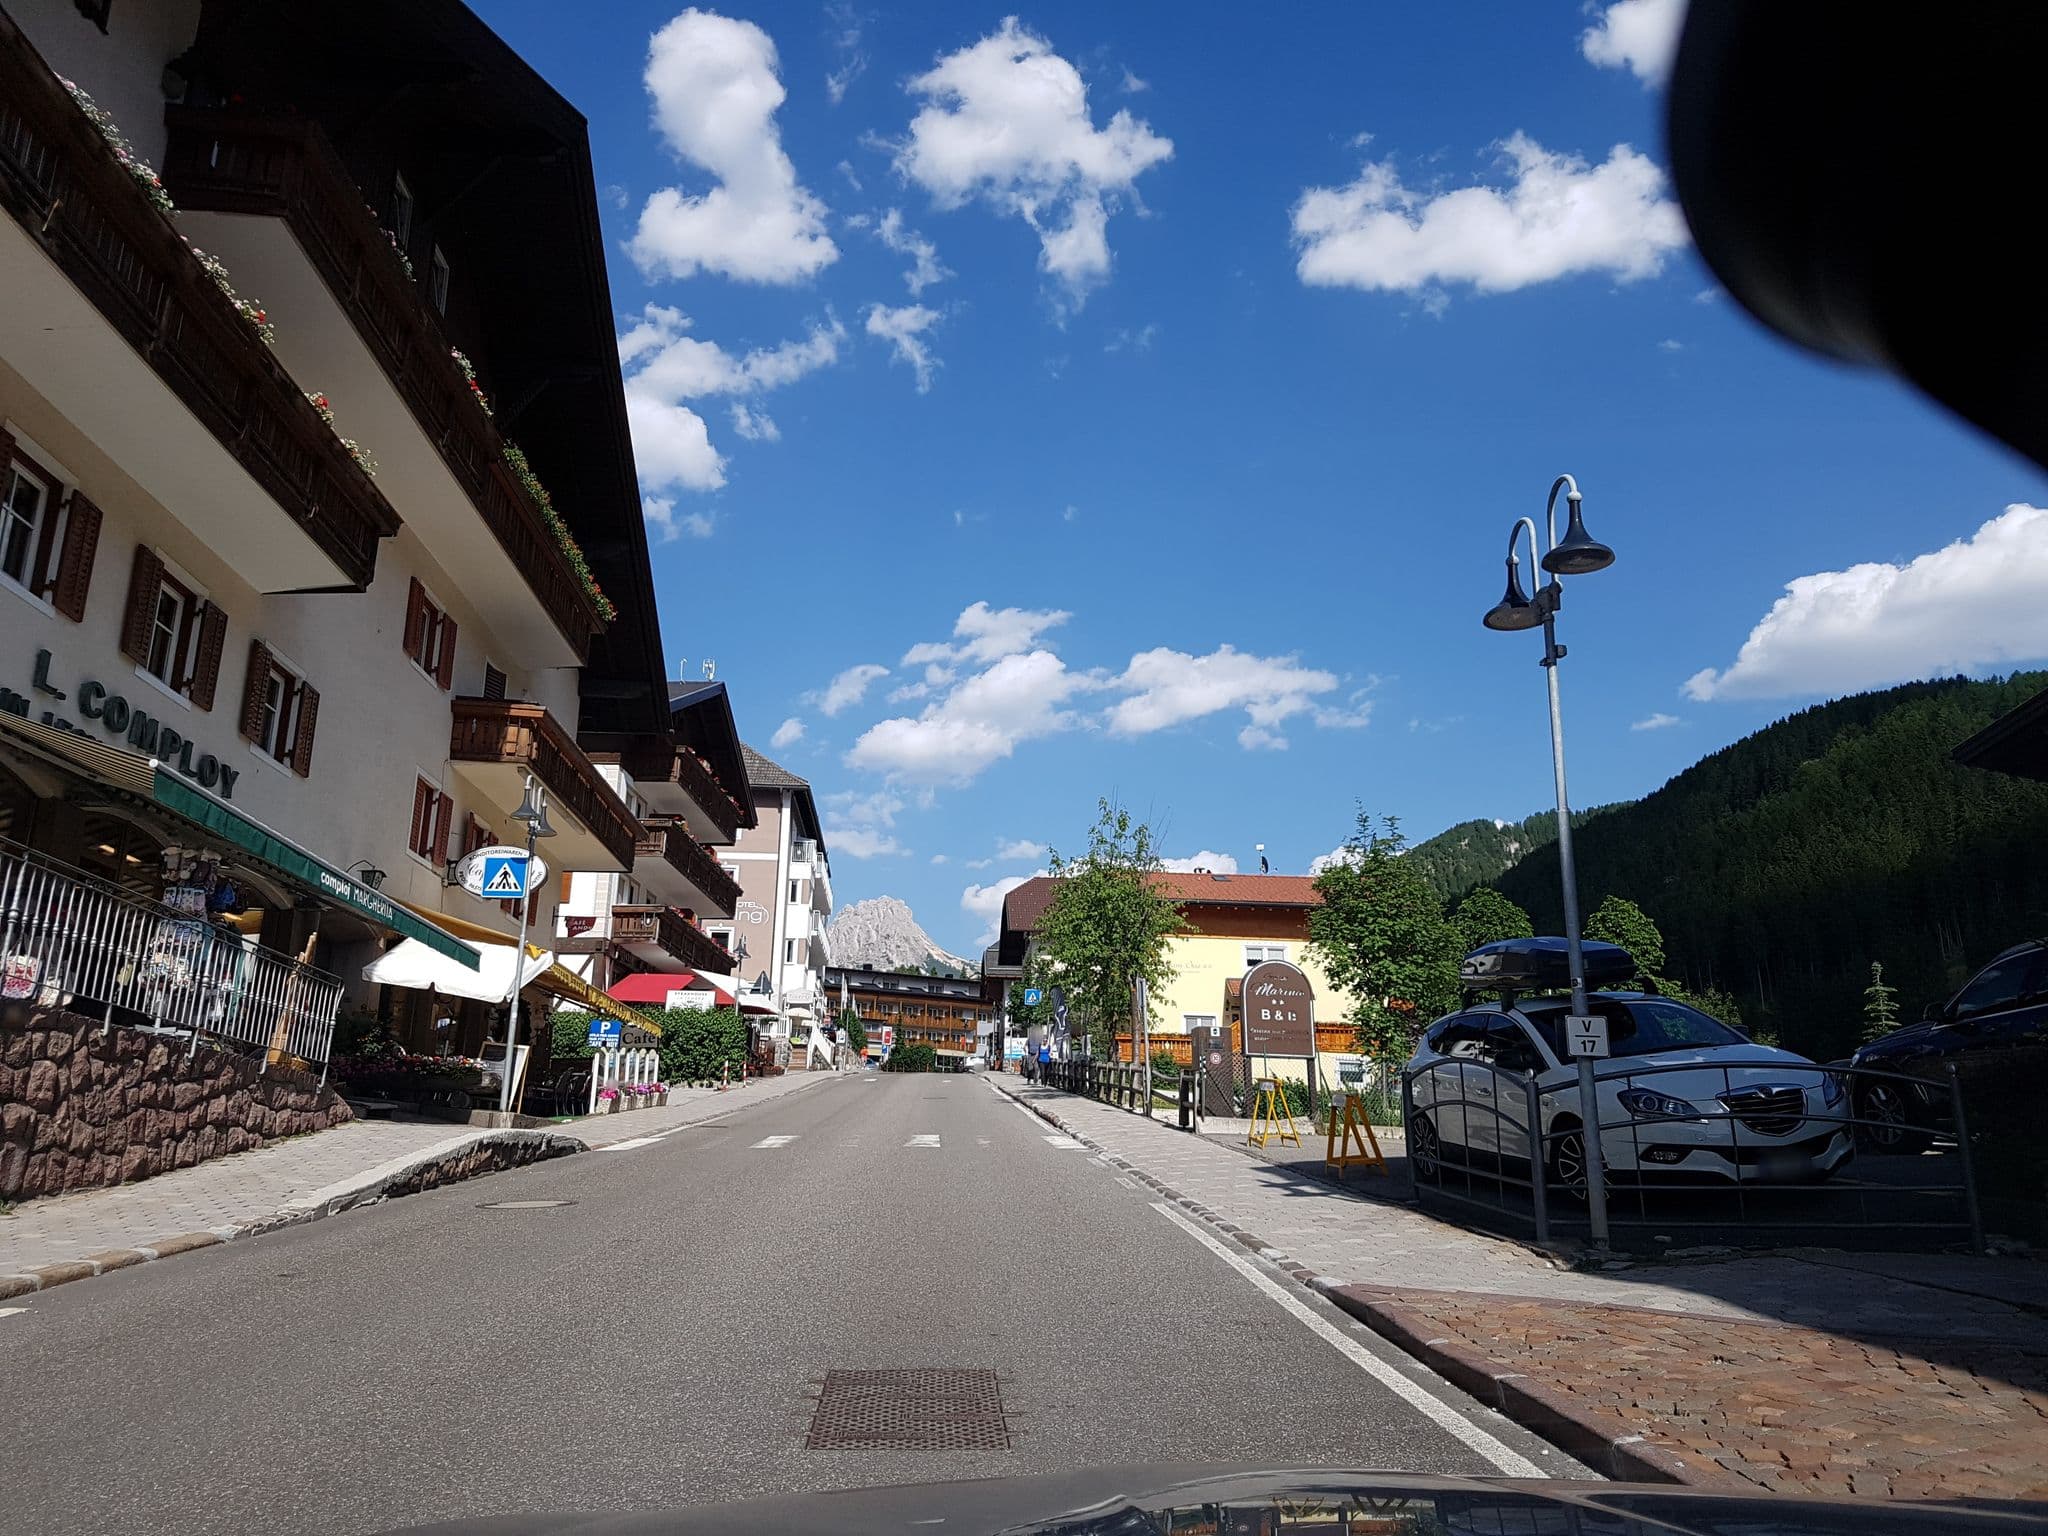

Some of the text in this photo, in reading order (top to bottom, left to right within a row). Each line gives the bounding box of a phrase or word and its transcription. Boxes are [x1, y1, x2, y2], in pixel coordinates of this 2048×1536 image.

[33, 649, 240, 800] L. COMPLOY
[320, 871, 352, 900] comploj
[1261, 1008, 1271, 1021] B
[1274, 1009, 1284, 1021] &
[600, 1021, 612, 1034] P
[1581, 1020, 1592, 1033] V
[1580, 1040, 1596, 1053] 17
